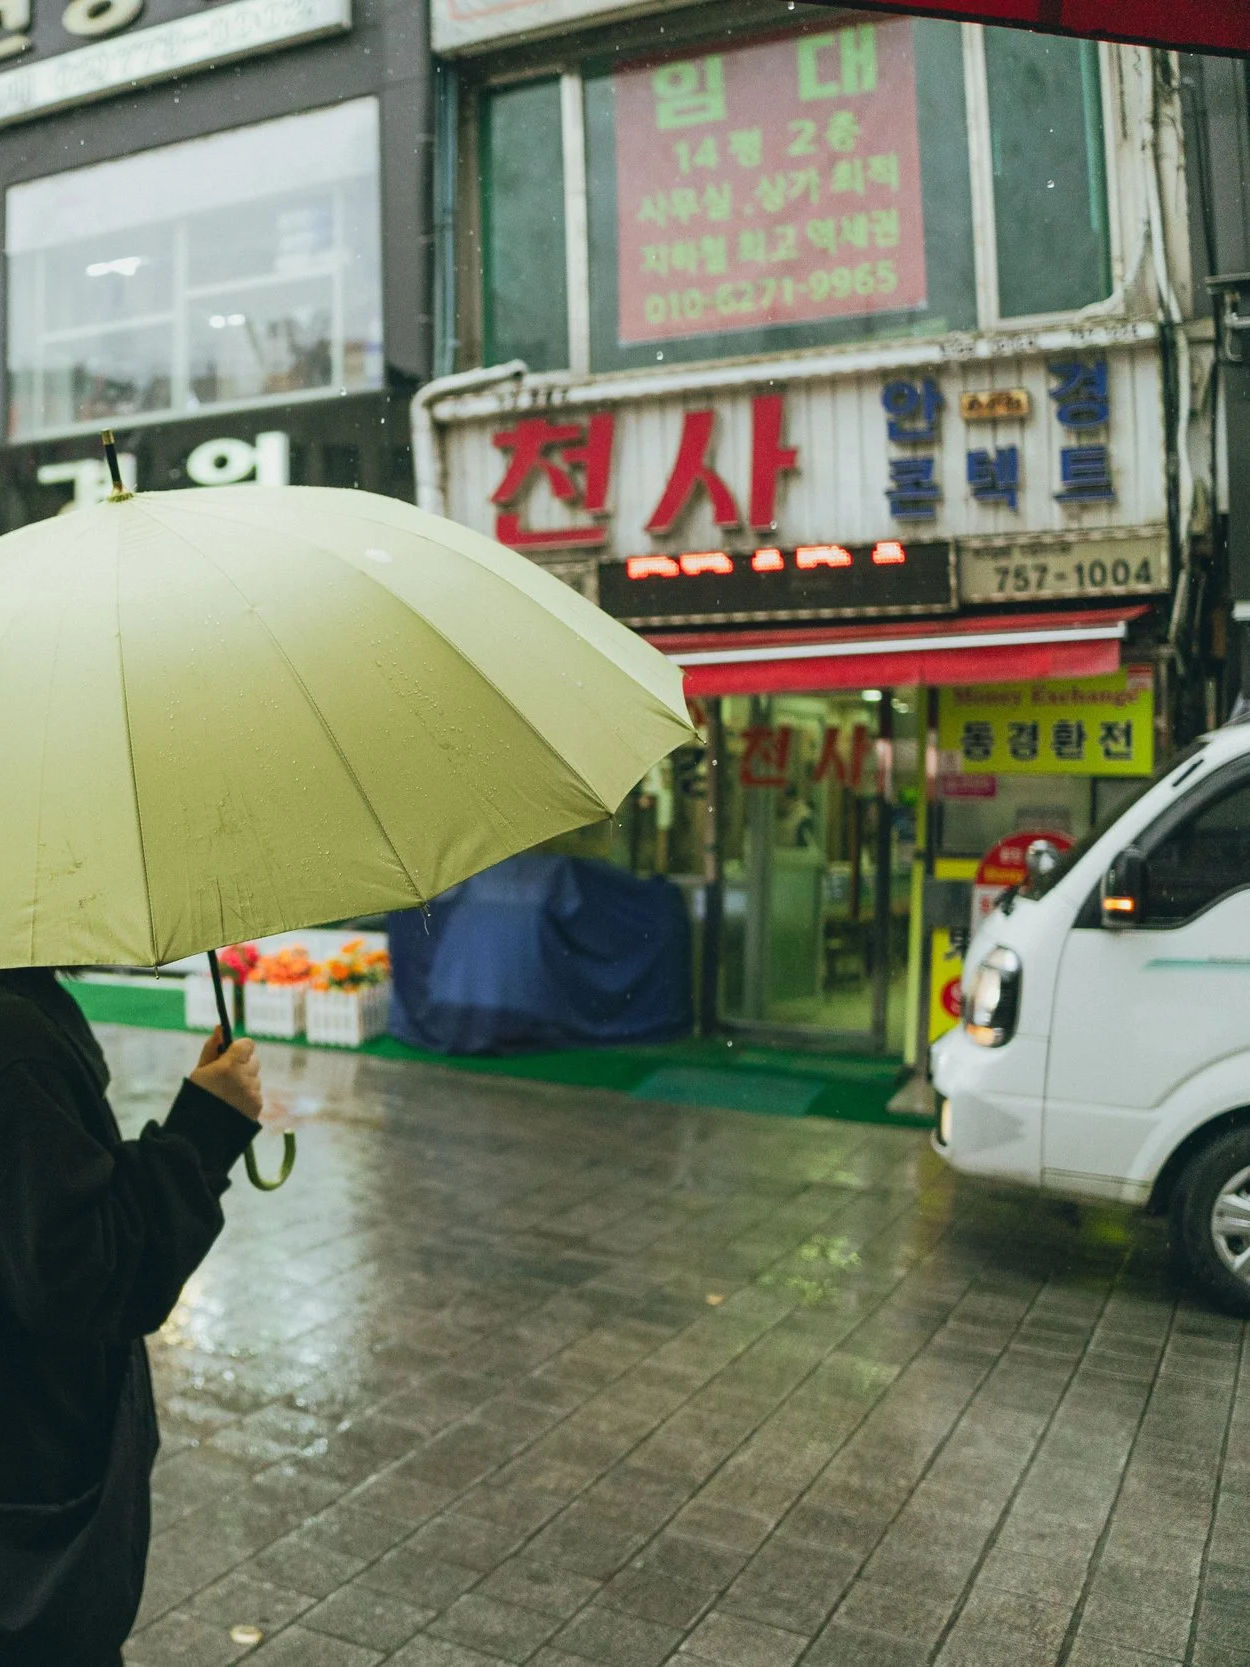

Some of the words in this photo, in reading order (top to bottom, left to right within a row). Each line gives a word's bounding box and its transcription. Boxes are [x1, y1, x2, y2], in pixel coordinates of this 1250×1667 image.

[640, 234, 728, 277] 지하철
[643, 259, 899, 325] 010-6271-9965
[491, 394, 807, 548] 천사
[993, 556, 1154, 594] 757-1004
